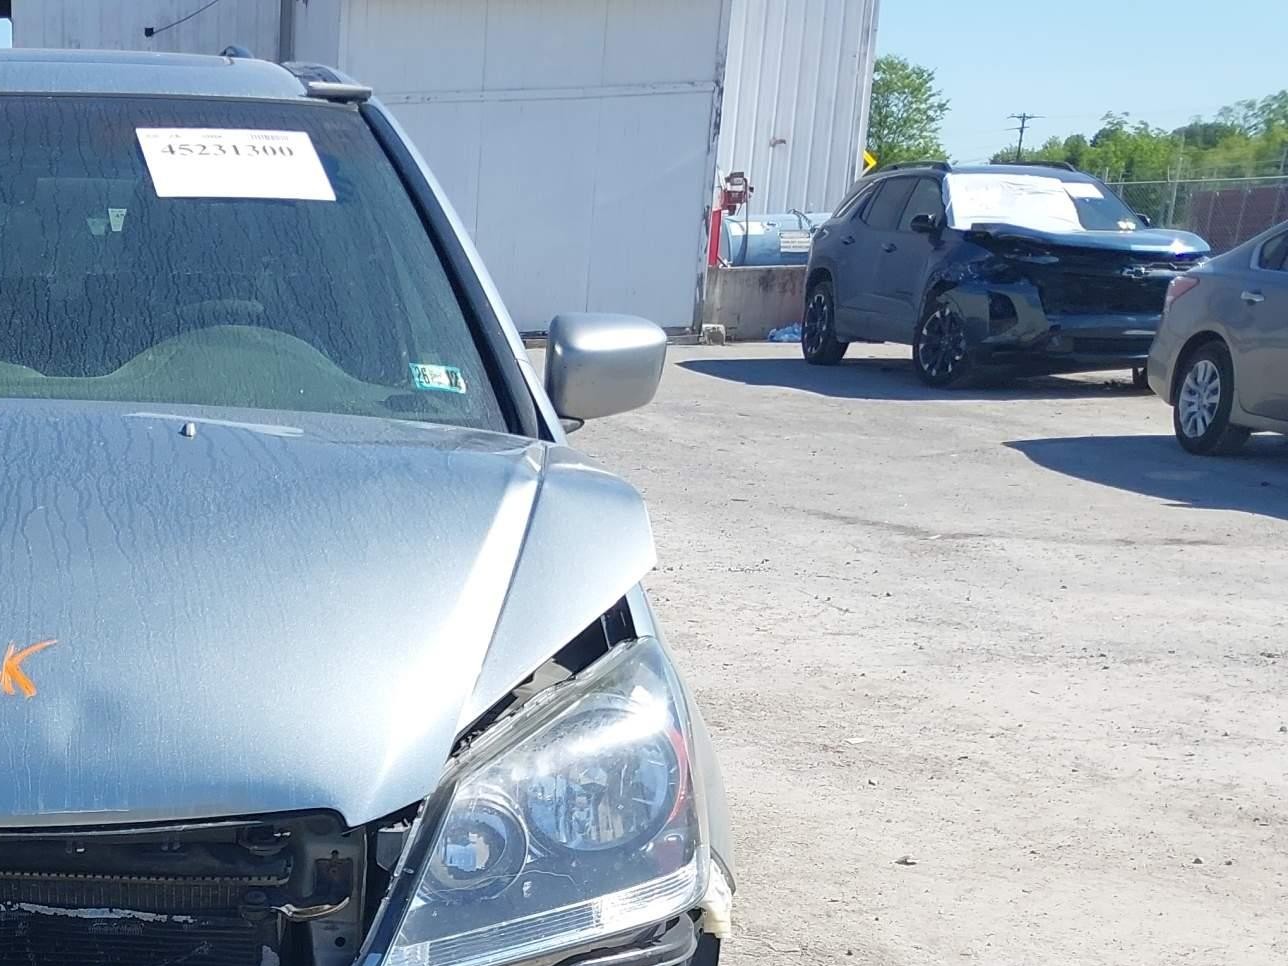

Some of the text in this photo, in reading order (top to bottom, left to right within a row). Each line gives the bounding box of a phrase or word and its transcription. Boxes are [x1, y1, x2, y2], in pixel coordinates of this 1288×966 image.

[161, 143, 295, 157] 45231300
[414, 366, 431, 385] 26
[445, 369, 463, 391] 12
